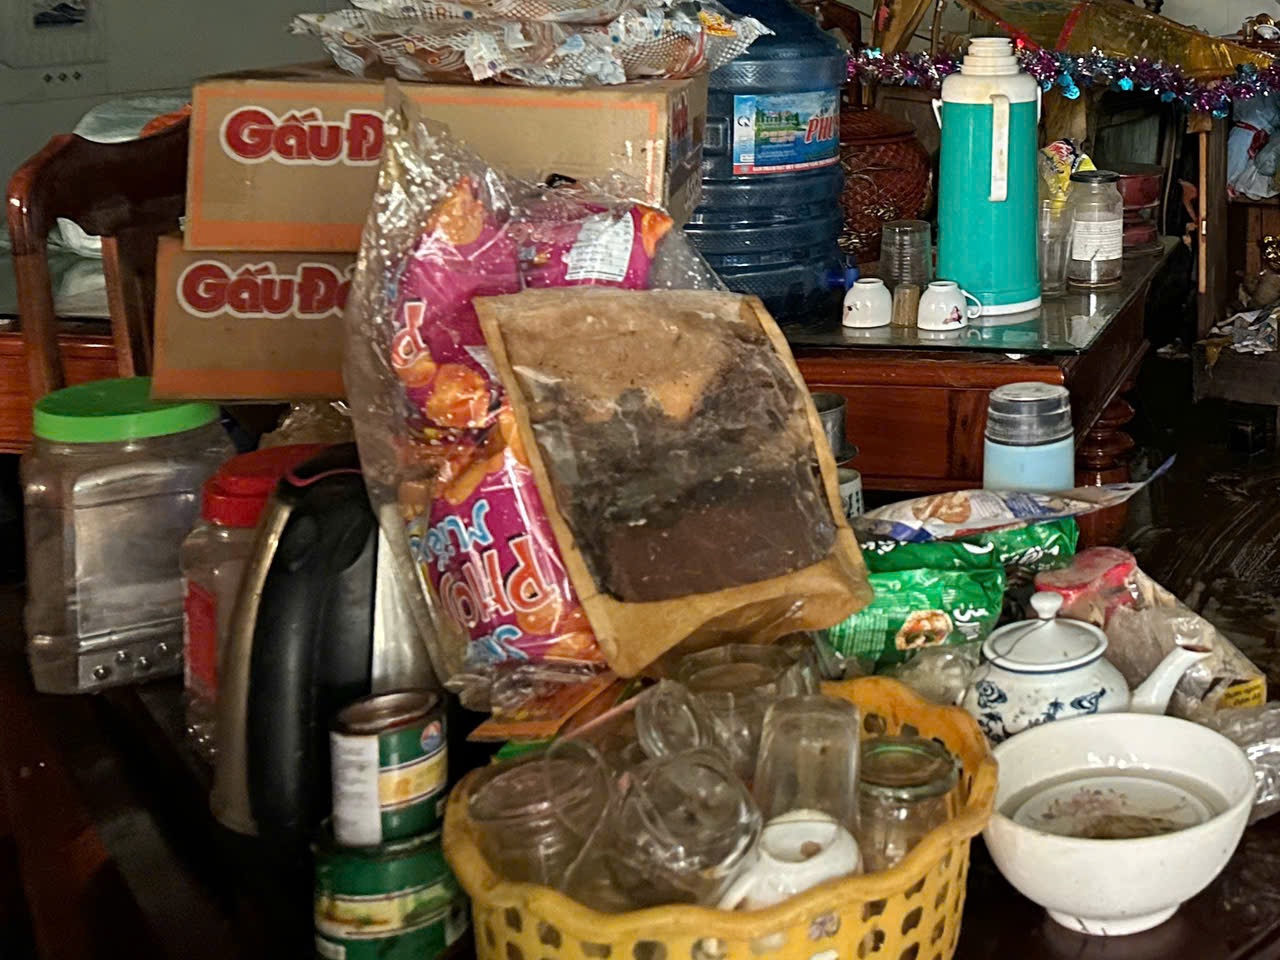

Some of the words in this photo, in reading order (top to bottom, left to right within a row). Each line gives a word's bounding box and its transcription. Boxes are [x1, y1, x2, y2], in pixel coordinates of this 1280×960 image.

[223, 108, 344, 162] Gấu
[346, 111, 384, 163] Đ
[180, 262, 295, 316] Gấu
